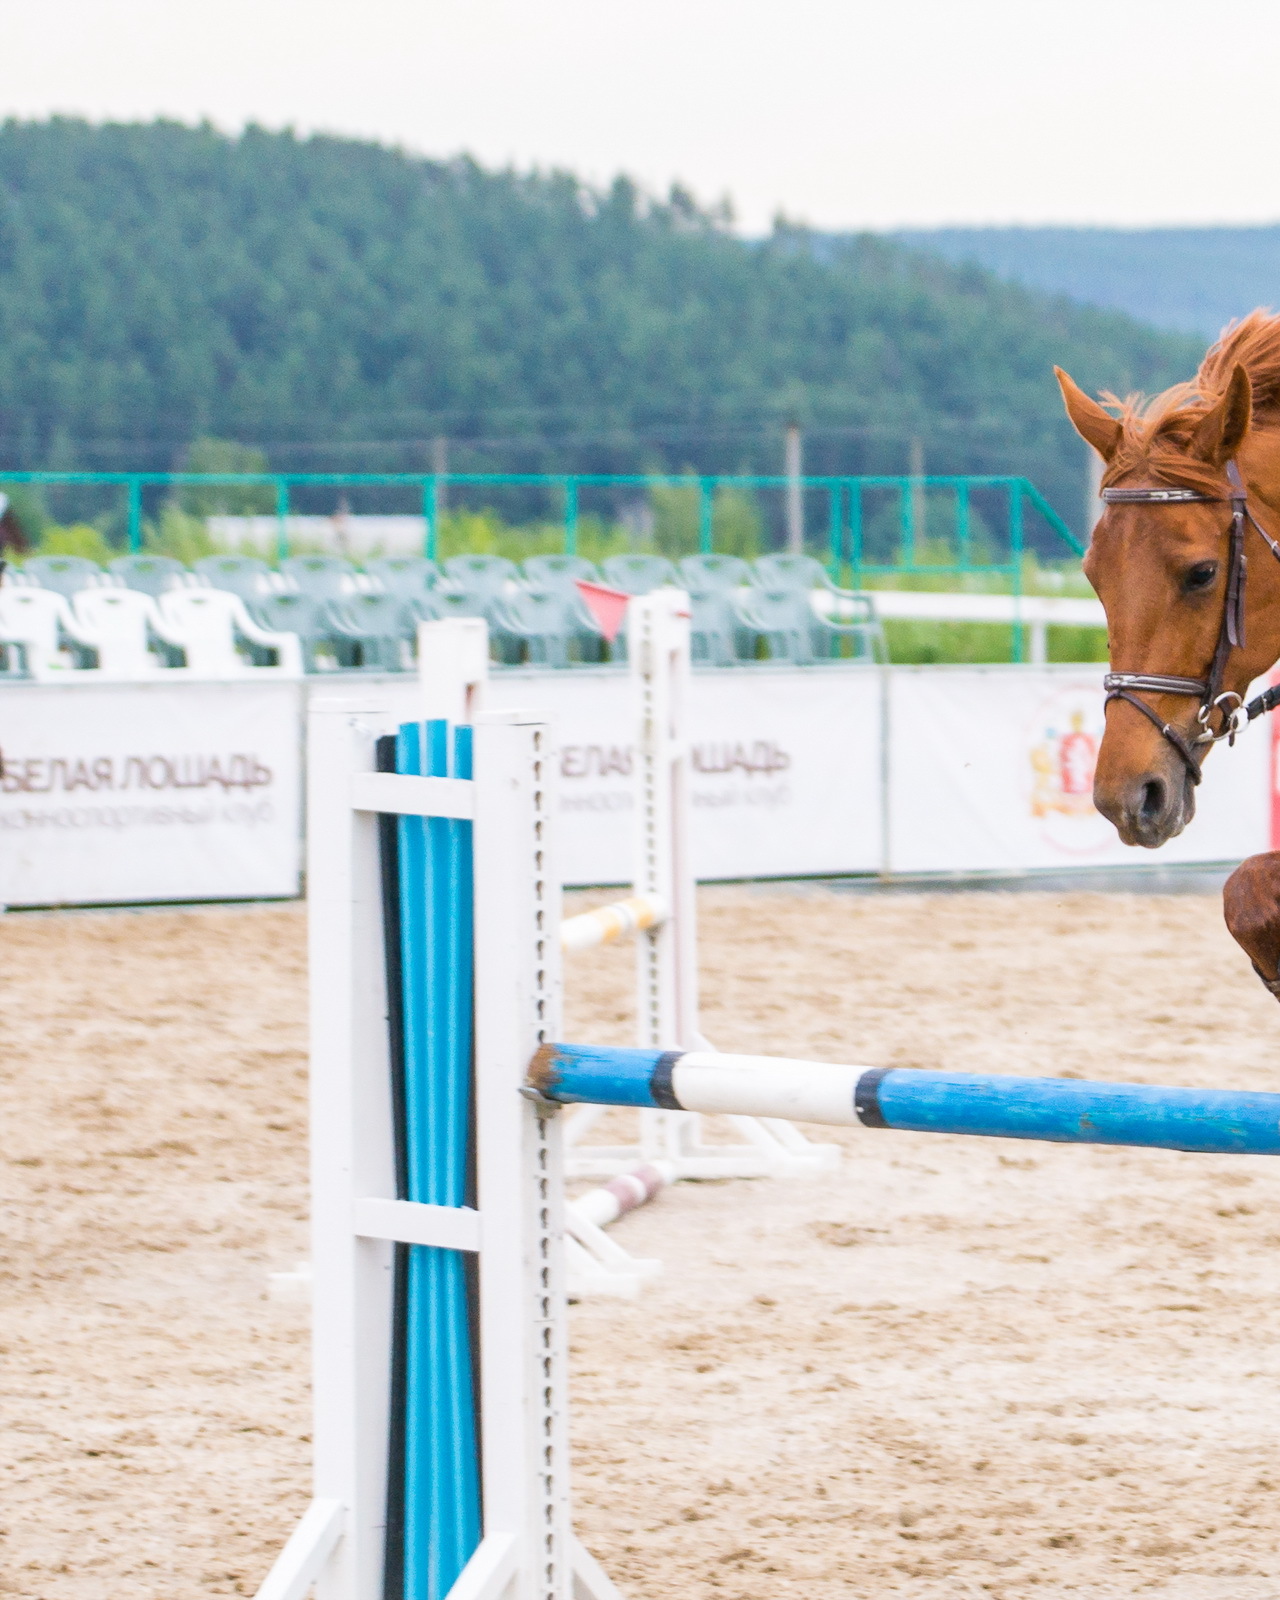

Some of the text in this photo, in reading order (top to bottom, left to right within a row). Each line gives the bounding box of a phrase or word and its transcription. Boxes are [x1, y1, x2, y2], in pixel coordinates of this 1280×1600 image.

[1, 753, 273, 793] БЕЛАЯ ЛОШАДЬ
[559, 740, 791, 779] ЕЛА ШАДЬ
